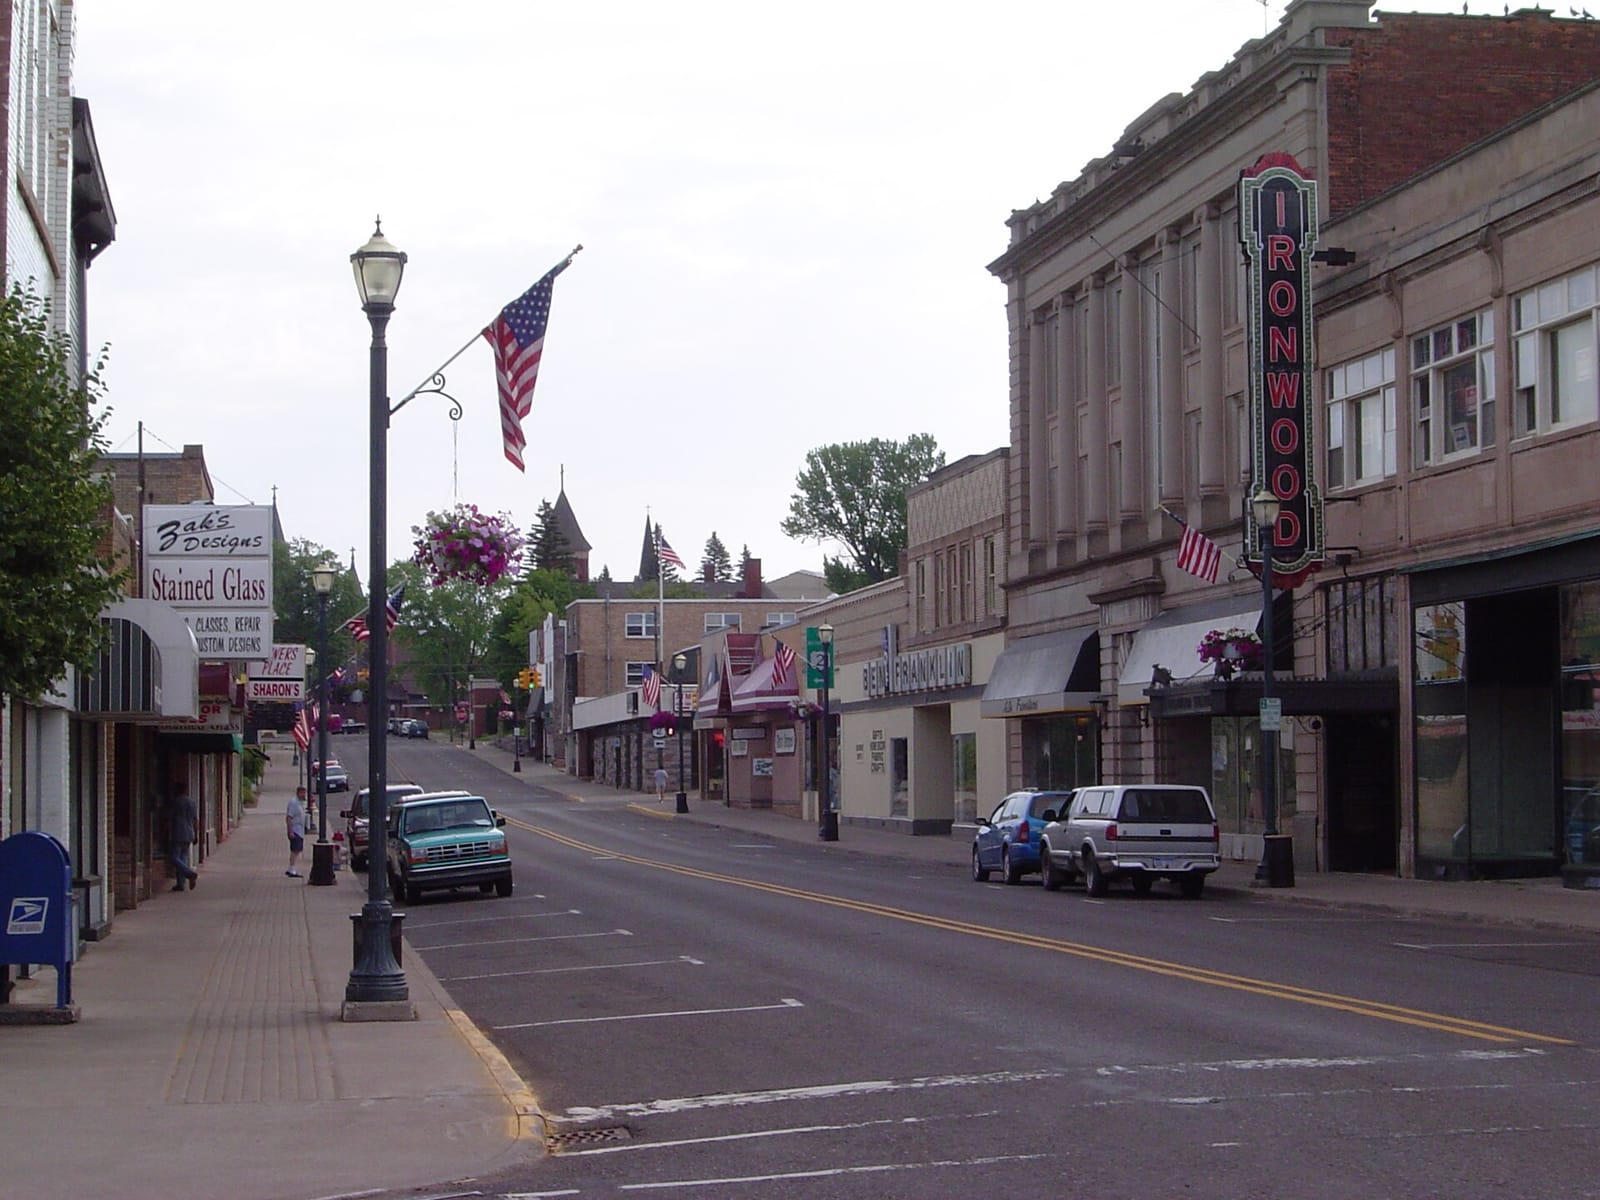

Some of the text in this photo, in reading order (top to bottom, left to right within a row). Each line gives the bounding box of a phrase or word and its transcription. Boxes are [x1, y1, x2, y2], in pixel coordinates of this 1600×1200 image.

[1268, 190, 1301, 547] IRONWOOD
[156, 510, 234, 552] Zak's
[183, 535, 263, 553] Designs
[152, 567, 265, 601] Stained Glass
[235, 616, 261, 632] REPAIR
[228, 637, 261, 652] DESIGNS
[261, 660, 292, 676] PLACE
[894, 649, 964, 690] FRANKLIN
[253, 683, 300, 697] SHARON'S
